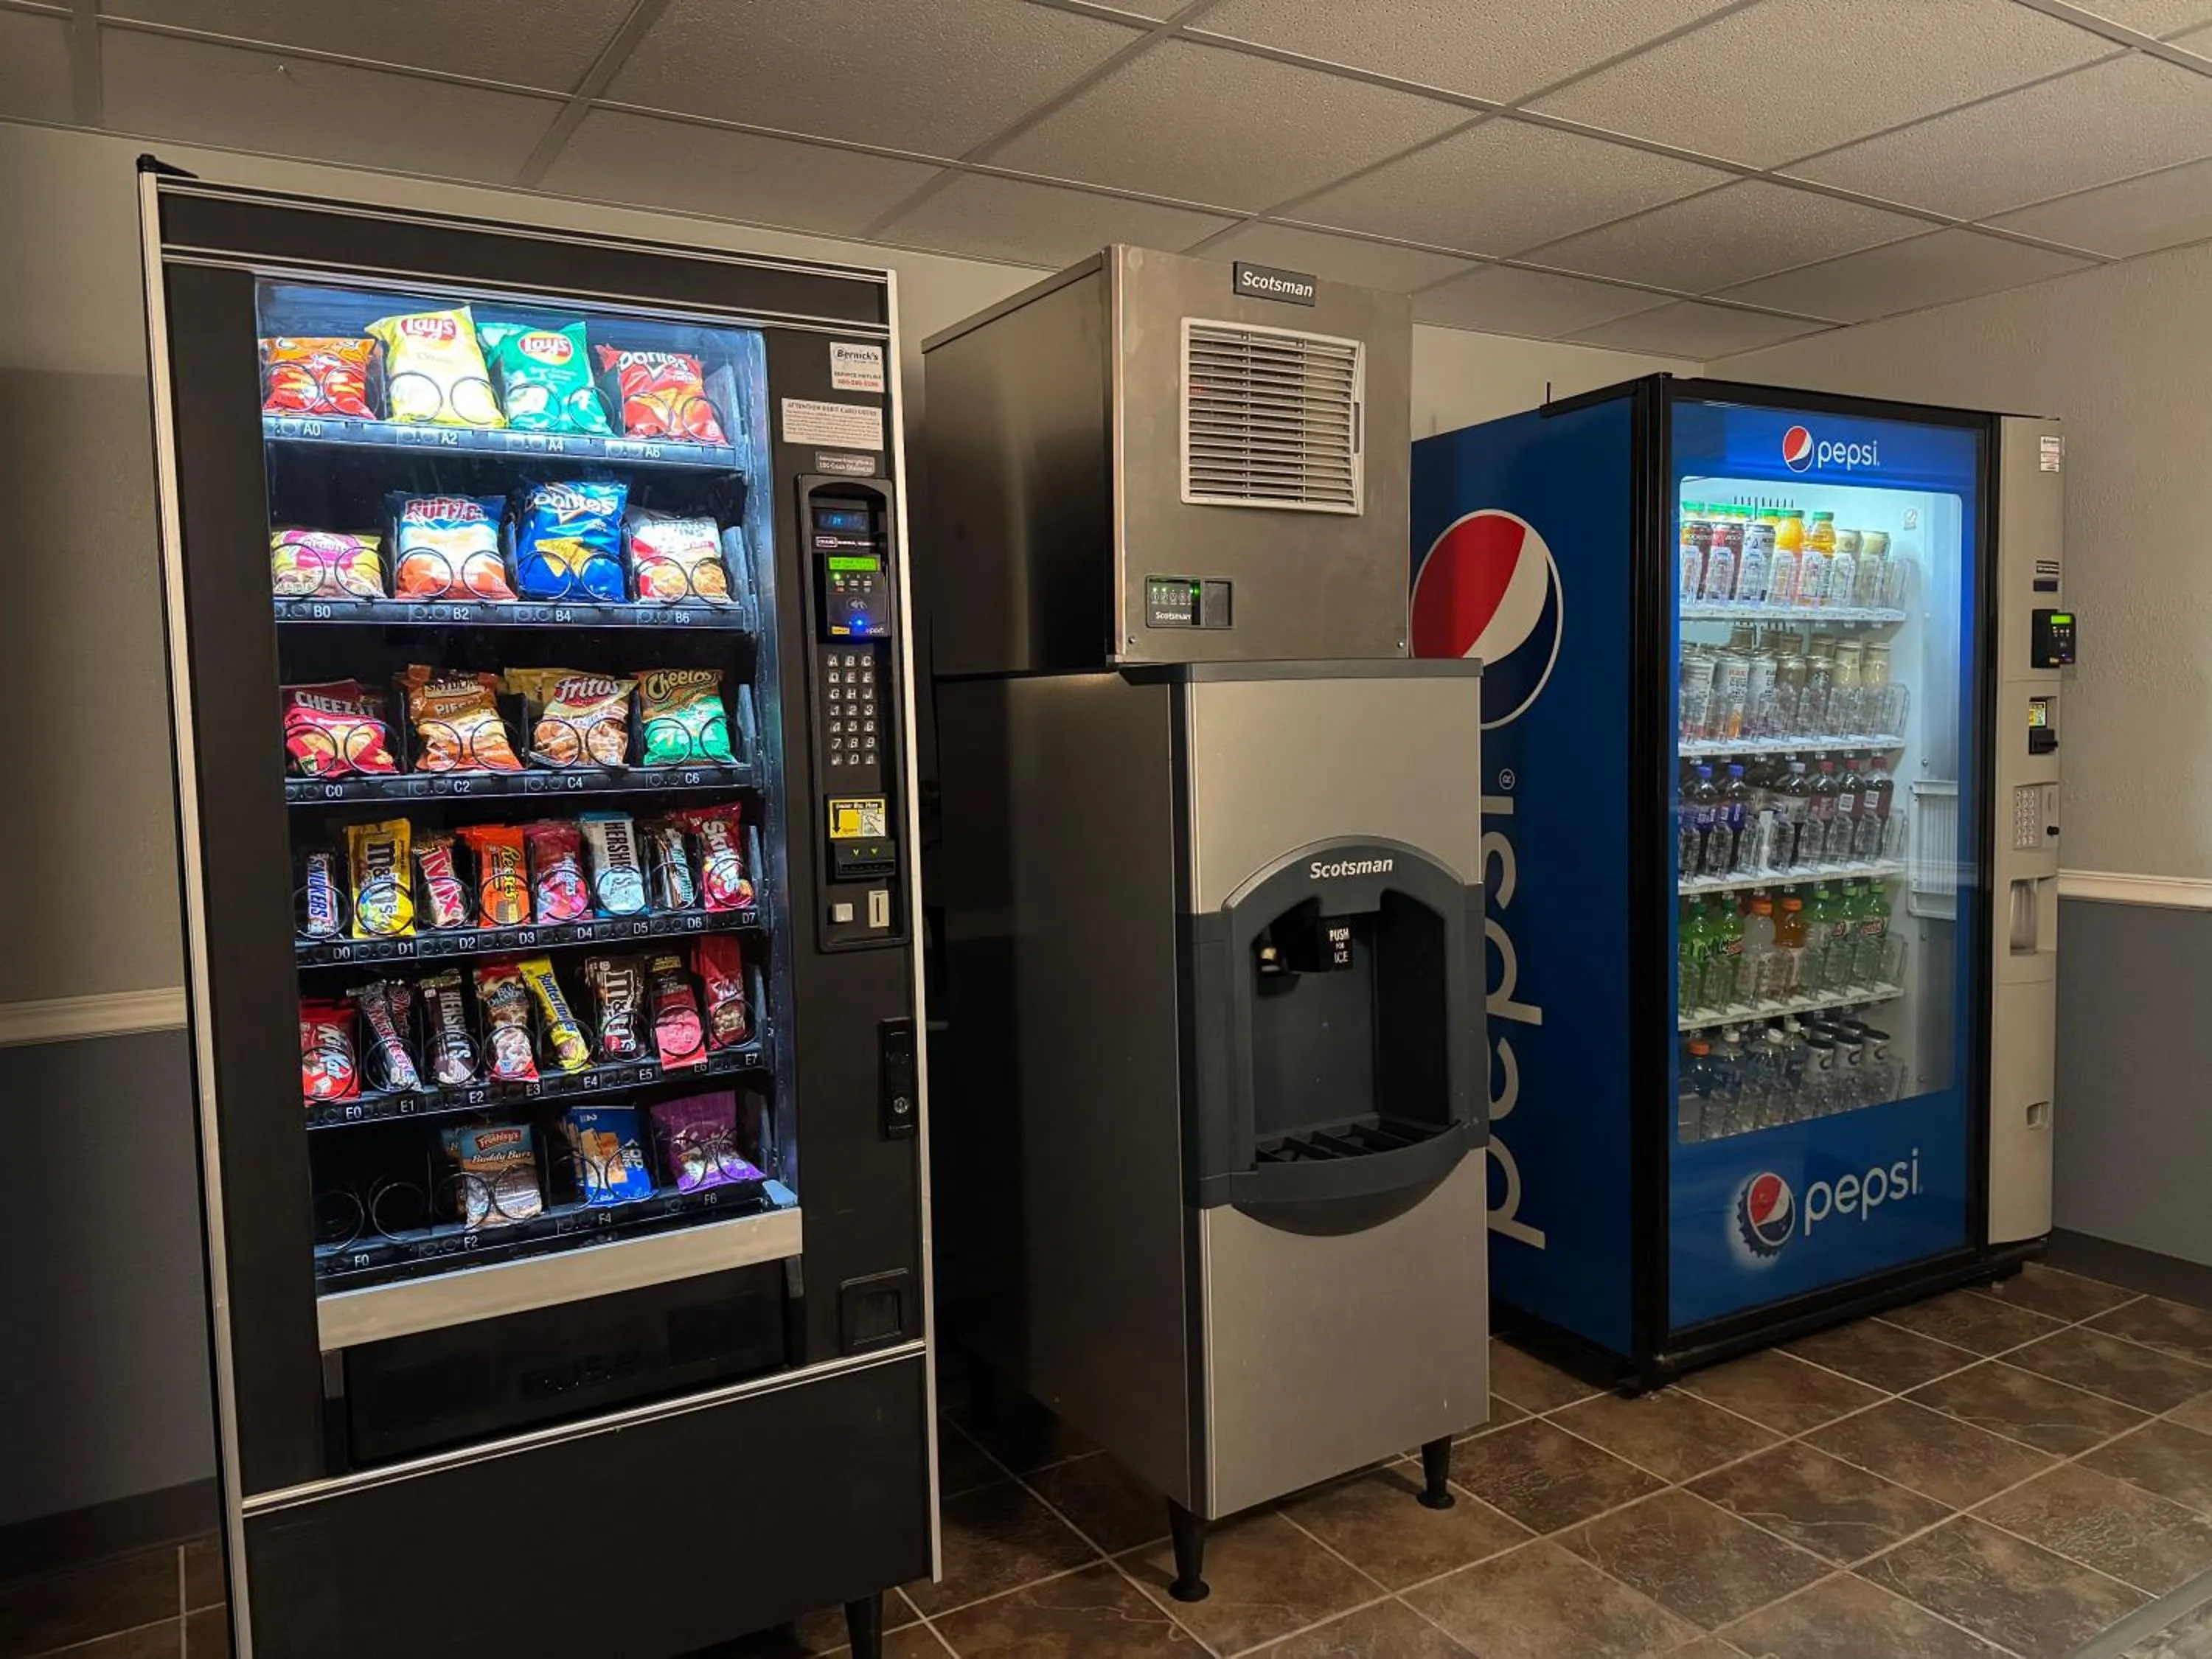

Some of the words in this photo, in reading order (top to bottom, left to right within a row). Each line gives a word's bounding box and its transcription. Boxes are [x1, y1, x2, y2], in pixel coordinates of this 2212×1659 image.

[1242, 271, 1312, 297] Scotsman
[302, 422, 321, 435] A0
[441, 433, 458, 445] A2
[548, 440, 564, 452] A4
[645, 446, 661, 458] A6
[1818, 440, 1878, 470] pepsi
[313, 605, 331, 618] B0
[453, 607, 470, 620] B2
[555, 610, 571, 622] B4
[675, 610, 689, 623] B6
[829, 655, 838, 667] A
[846, 655, 855, 667] B
[862, 655, 872, 667] C
[830, 689, 840, 700] G
[846, 688, 856, 700] H
[863, 688, 873, 700] J
[848, 705, 858, 716] 2
[864, 704, 874, 716] 3
[848, 720, 858, 732] 5
[832, 738, 841, 750] 7
[849, 737, 858, 748] 8
[567, 777, 583, 789] C4
[684, 772, 700, 784] C6
[325, 785, 343, 797] C0
[453, 780, 470, 793] C2
[1310, 859, 1393, 879] Scotsman
[419, 846, 464, 917] TWIX
[687, 917, 702, 929] D6
[742, 913, 756, 925] D7
[577, 927, 593, 939] D4
[633, 922, 648, 934] D5
[519, 932, 535, 945] D3
[1329, 928, 1350, 942] PUSH
[398, 942, 414, 954] D1
[459, 937, 476, 949] D2
[333, 947, 350, 959] D0
[745, 1053, 757, 1065] E7
[639, 1068, 653, 1081] E5
[583, 1076, 598, 1088] E4
[526, 1083, 540, 1096] E3
[469, 1091, 484, 1104] E2
[400, 1099, 414, 1112] E1
[345, 1107, 362, 1119] E0
[1804, 1147, 1919, 1237] pepsi
[704, 1193, 717, 1206] F6
[598, 1212, 612, 1225] F4
[464, 1236, 479, 1248] F2
[355, 1254, 369, 1267] F0
